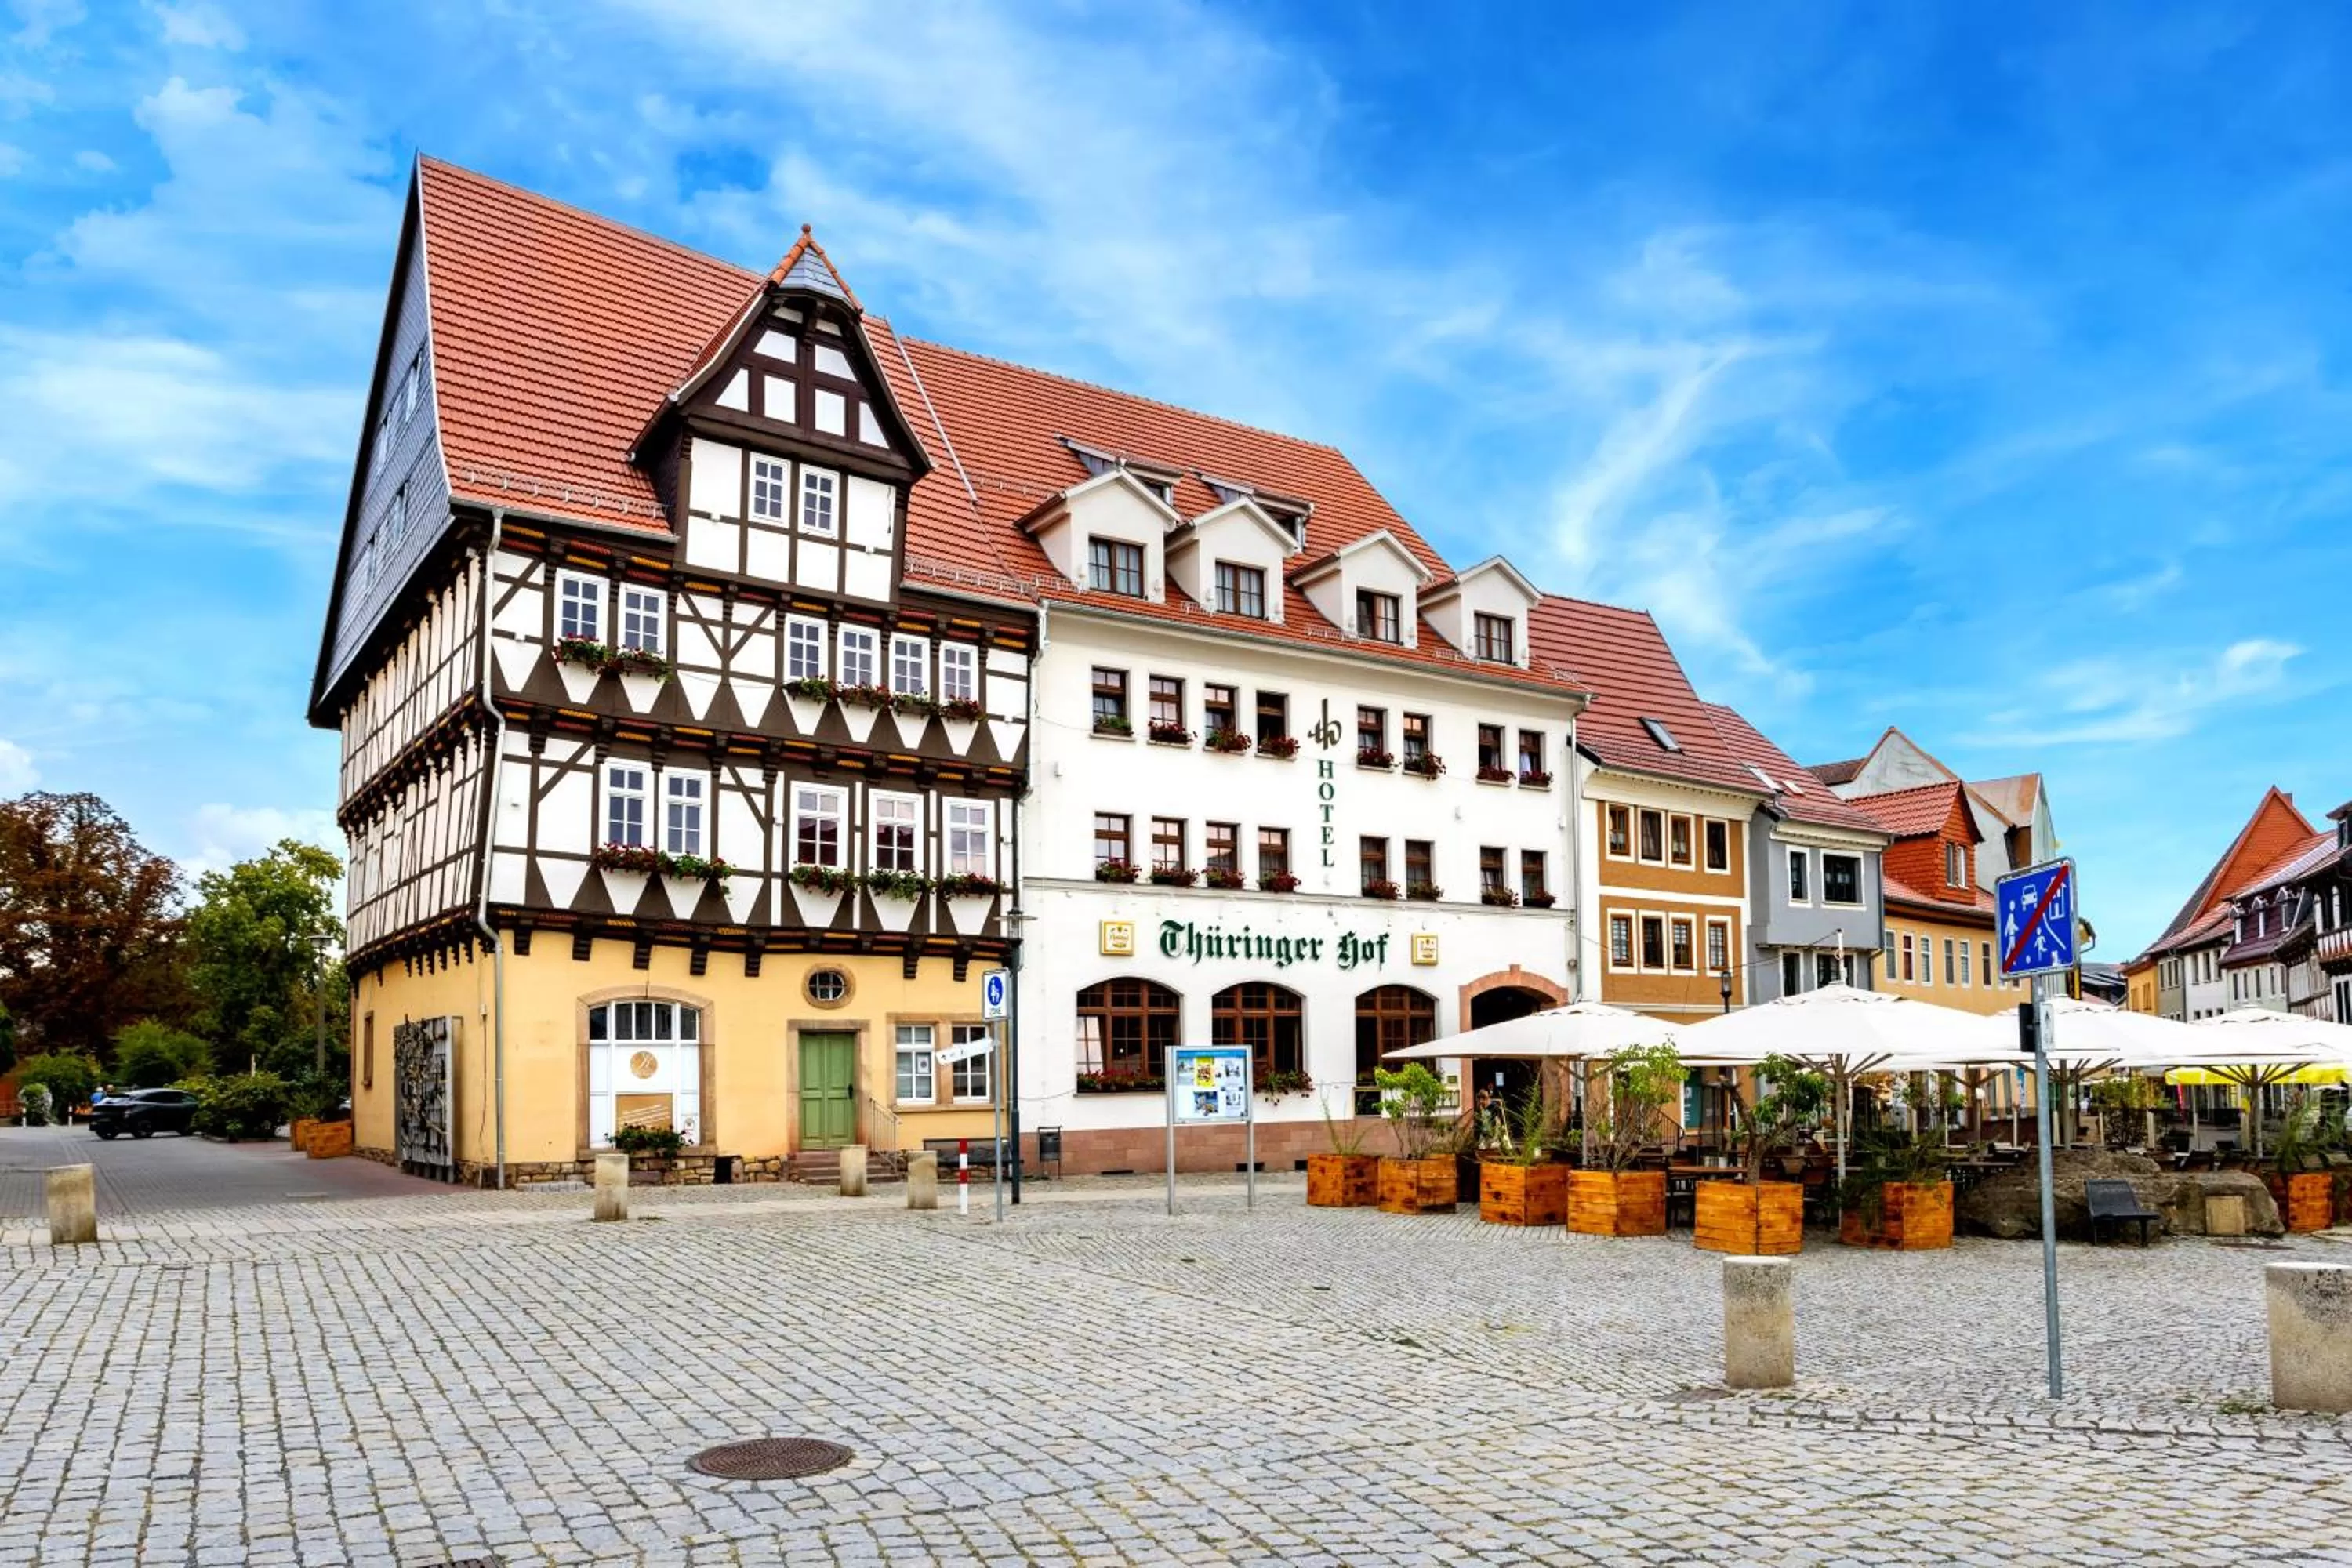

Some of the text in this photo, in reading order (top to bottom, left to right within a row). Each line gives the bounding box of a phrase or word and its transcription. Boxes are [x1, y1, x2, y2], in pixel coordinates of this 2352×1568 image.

[1318, 759, 1334, 867] HOTEL
[1160, 920, 1390, 971] Thüringer Hof
